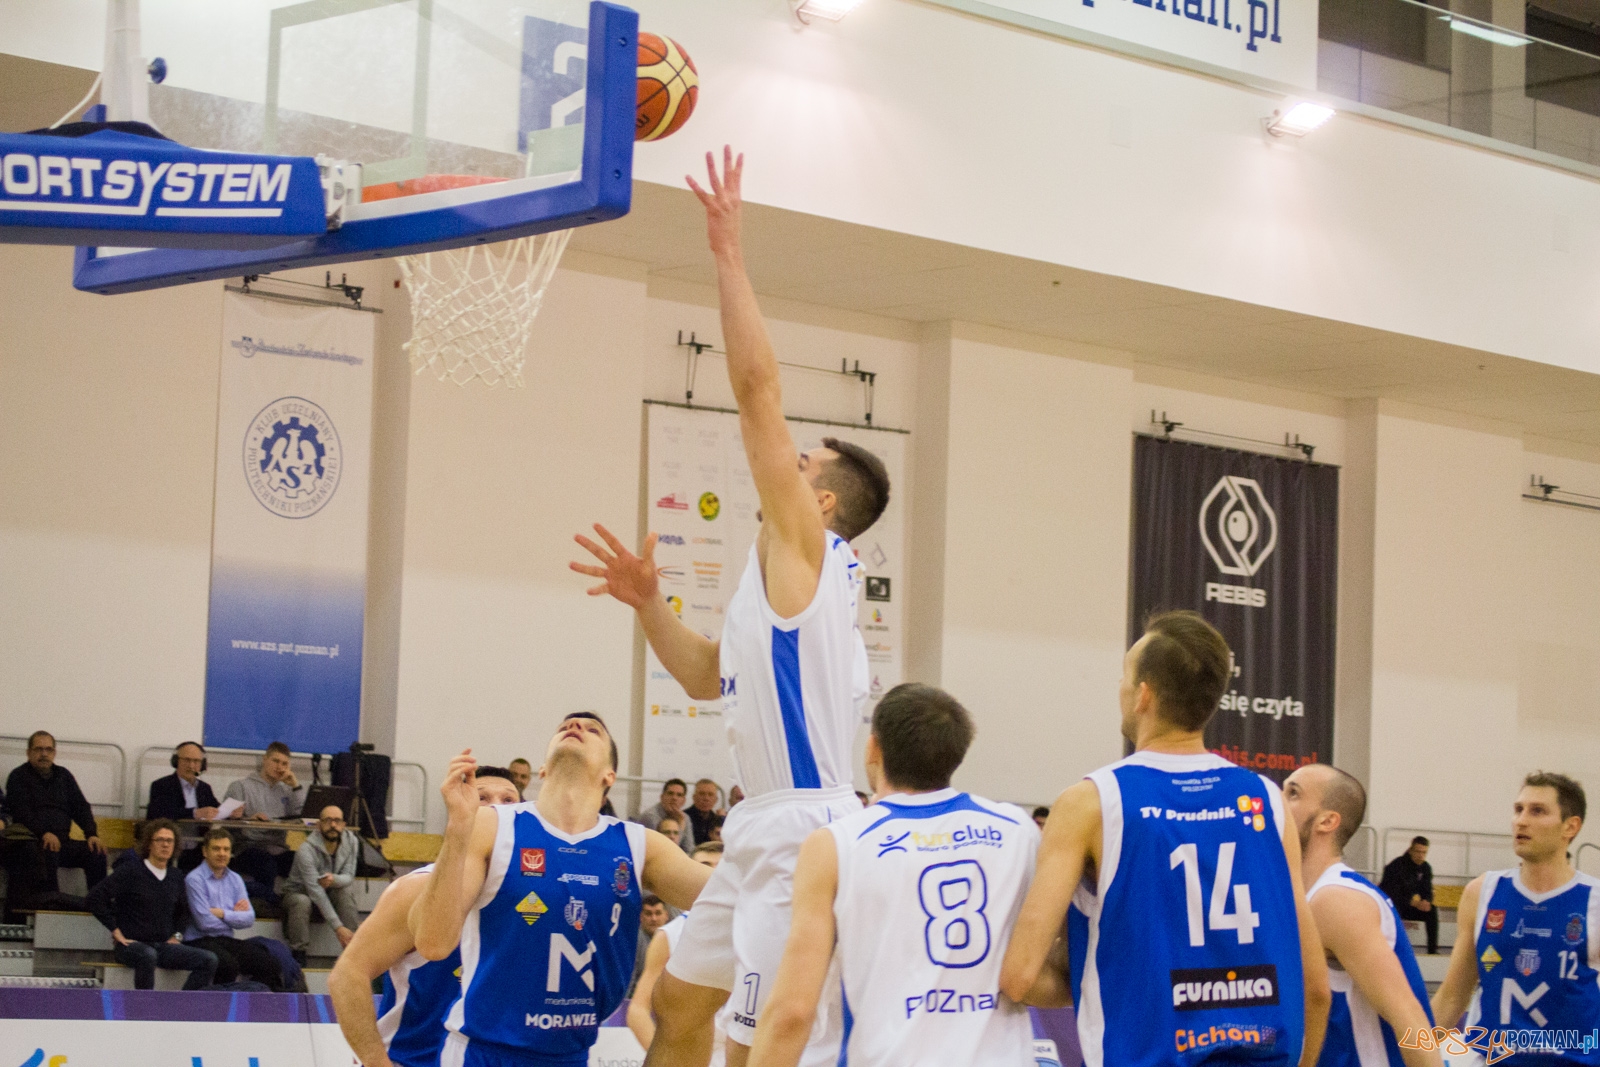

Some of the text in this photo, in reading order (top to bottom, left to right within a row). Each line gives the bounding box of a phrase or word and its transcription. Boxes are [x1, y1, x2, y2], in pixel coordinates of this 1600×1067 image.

[1206, 582, 1266, 607] REBIS
[1219, 690, 1304, 720] się czyta
[1140, 806, 1236, 821] TV Prudnik
[912, 825, 1003, 846] funclub
[1170, 842, 1260, 947] 14
[608, 903, 622, 936] 9
[918, 859, 991, 969] 8
[1558, 950, 1580, 980] 12
[744, 972, 760, 1015] 1
[525, 1013, 597, 1030] MORAWIE
